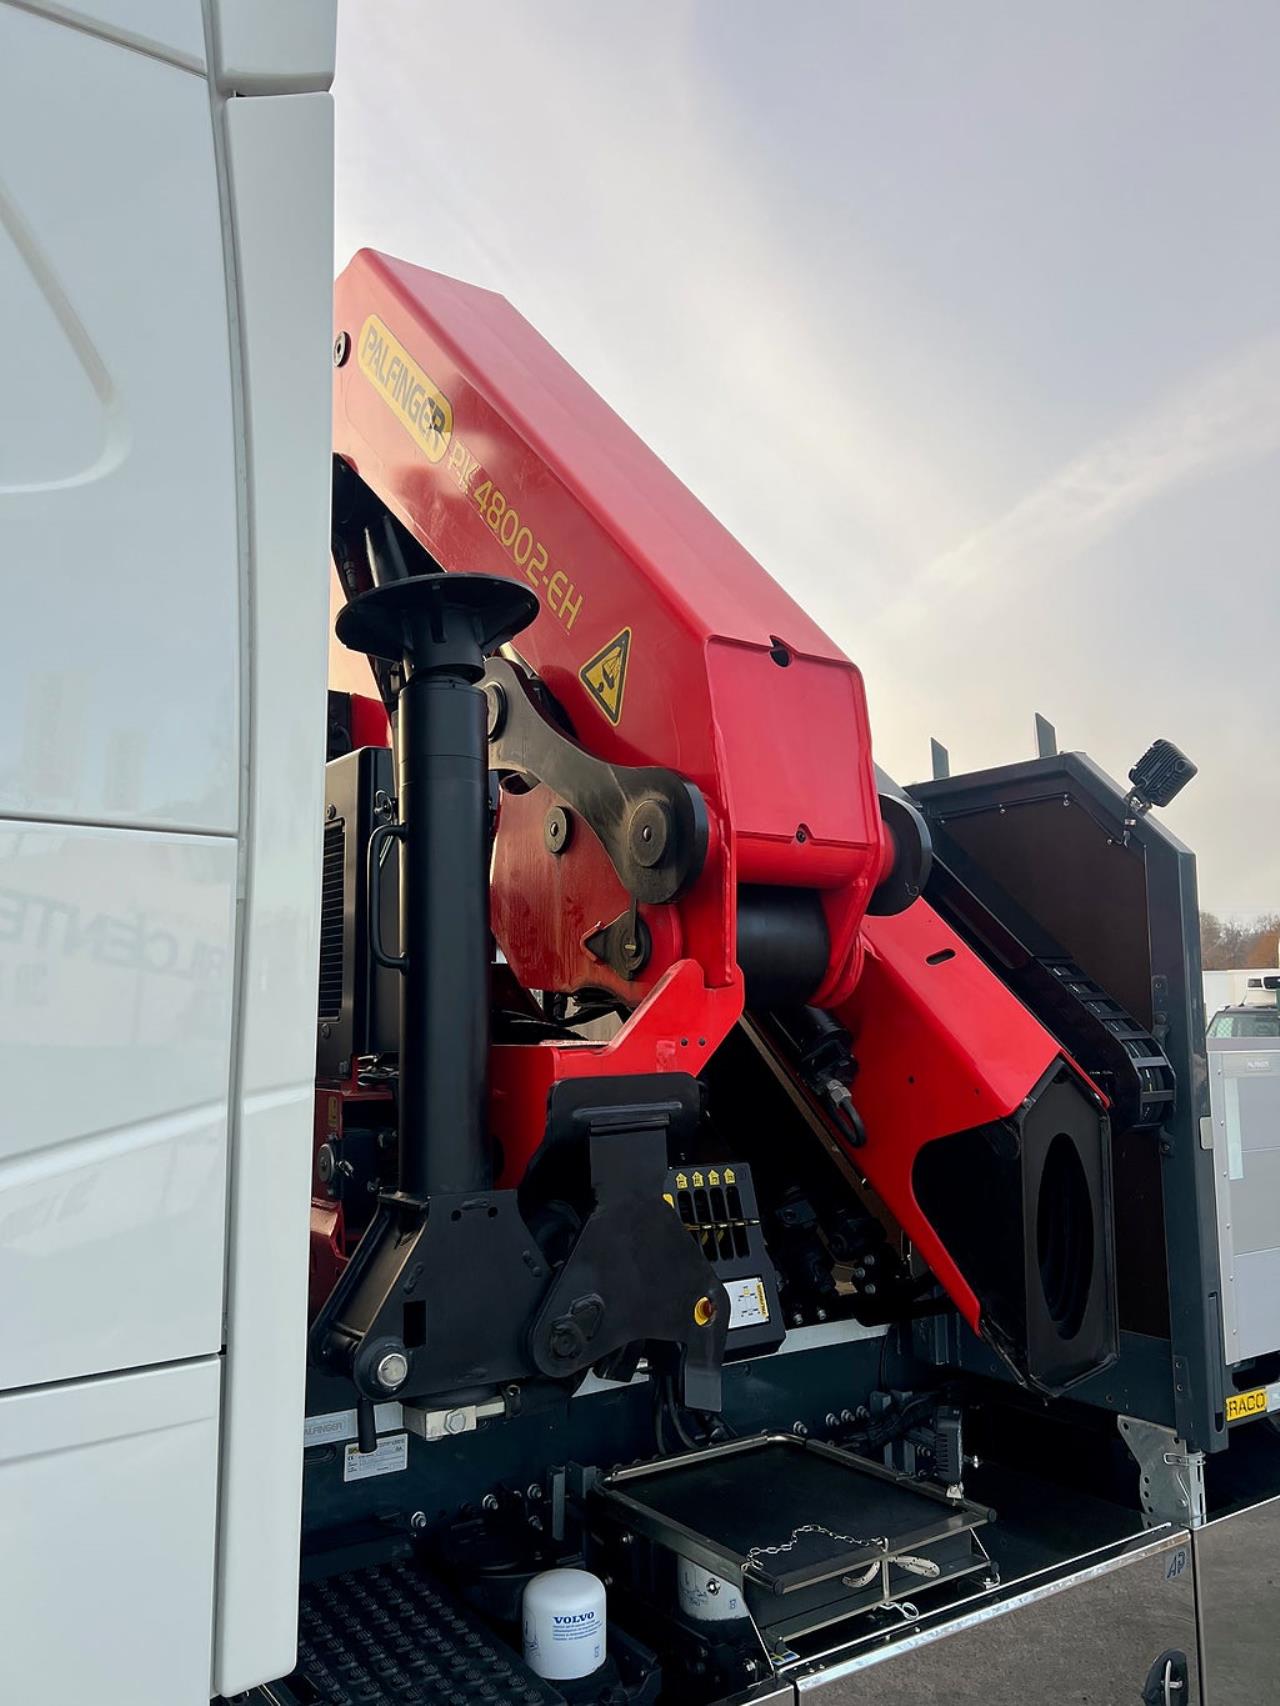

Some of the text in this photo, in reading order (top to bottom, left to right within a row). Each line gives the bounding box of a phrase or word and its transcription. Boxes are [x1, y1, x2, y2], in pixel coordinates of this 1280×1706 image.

[361, 323, 446, 454] PALFINGER
[449, 442, 584, 631] PK 48002-EH
[553, 1611, 595, 1624] VOLVO
